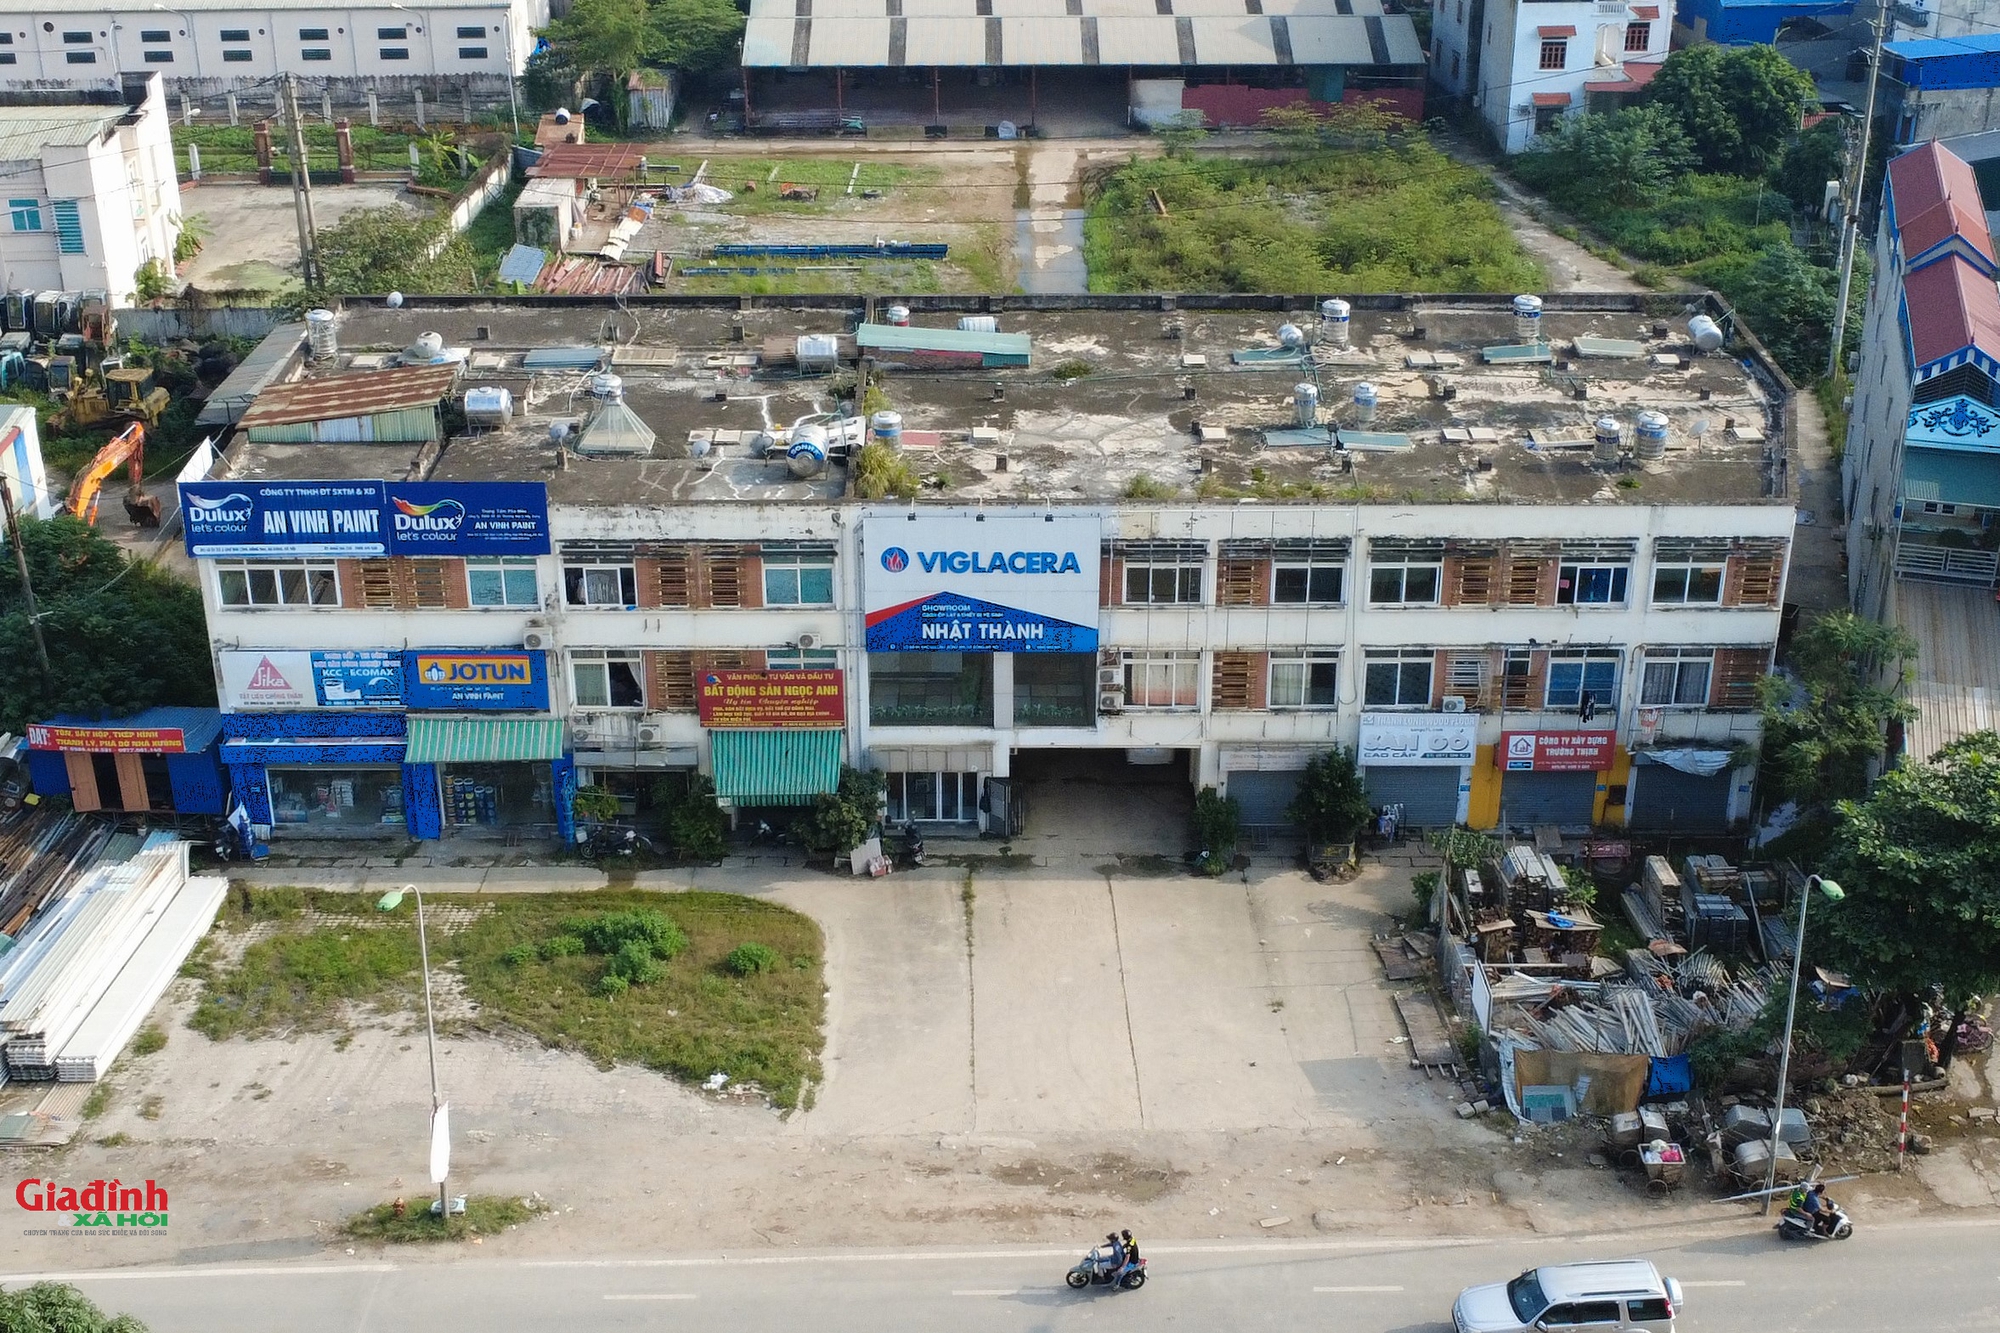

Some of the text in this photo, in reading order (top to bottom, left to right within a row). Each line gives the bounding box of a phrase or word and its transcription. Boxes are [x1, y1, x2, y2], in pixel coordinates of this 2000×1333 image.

[260, 488, 283, 496] CÔNG
[364, 488, 376, 496] XD
[190, 507, 247, 523] Dulux
[264, 509, 379, 534] AN VINH PAINT
[394, 514, 457, 531] Dulux
[475, 521, 536, 530] AN VINH PAINT
[192, 524, 248, 533] let's colour
[397, 532, 419, 541] let's
[421, 532, 458, 541] colour
[916, 551, 1081, 574] VIGLACERA
[921, 604, 971, 612] SHOWROOM
[921, 619, 1044, 642] NHẬT THÀNH
[253, 667, 285, 687] Sika
[322, 669, 343, 677] KCC
[350, 668, 395, 677] ECOMAX
[449, 663, 526, 681] JOTUN
[452, 692, 464, 700] AN
[704, 683, 838, 698] BẤT ĐỘNG SẢN NGỌC ANH
[1538, 736, 1608, 746] CÔNG TY XÂY DỰNG
